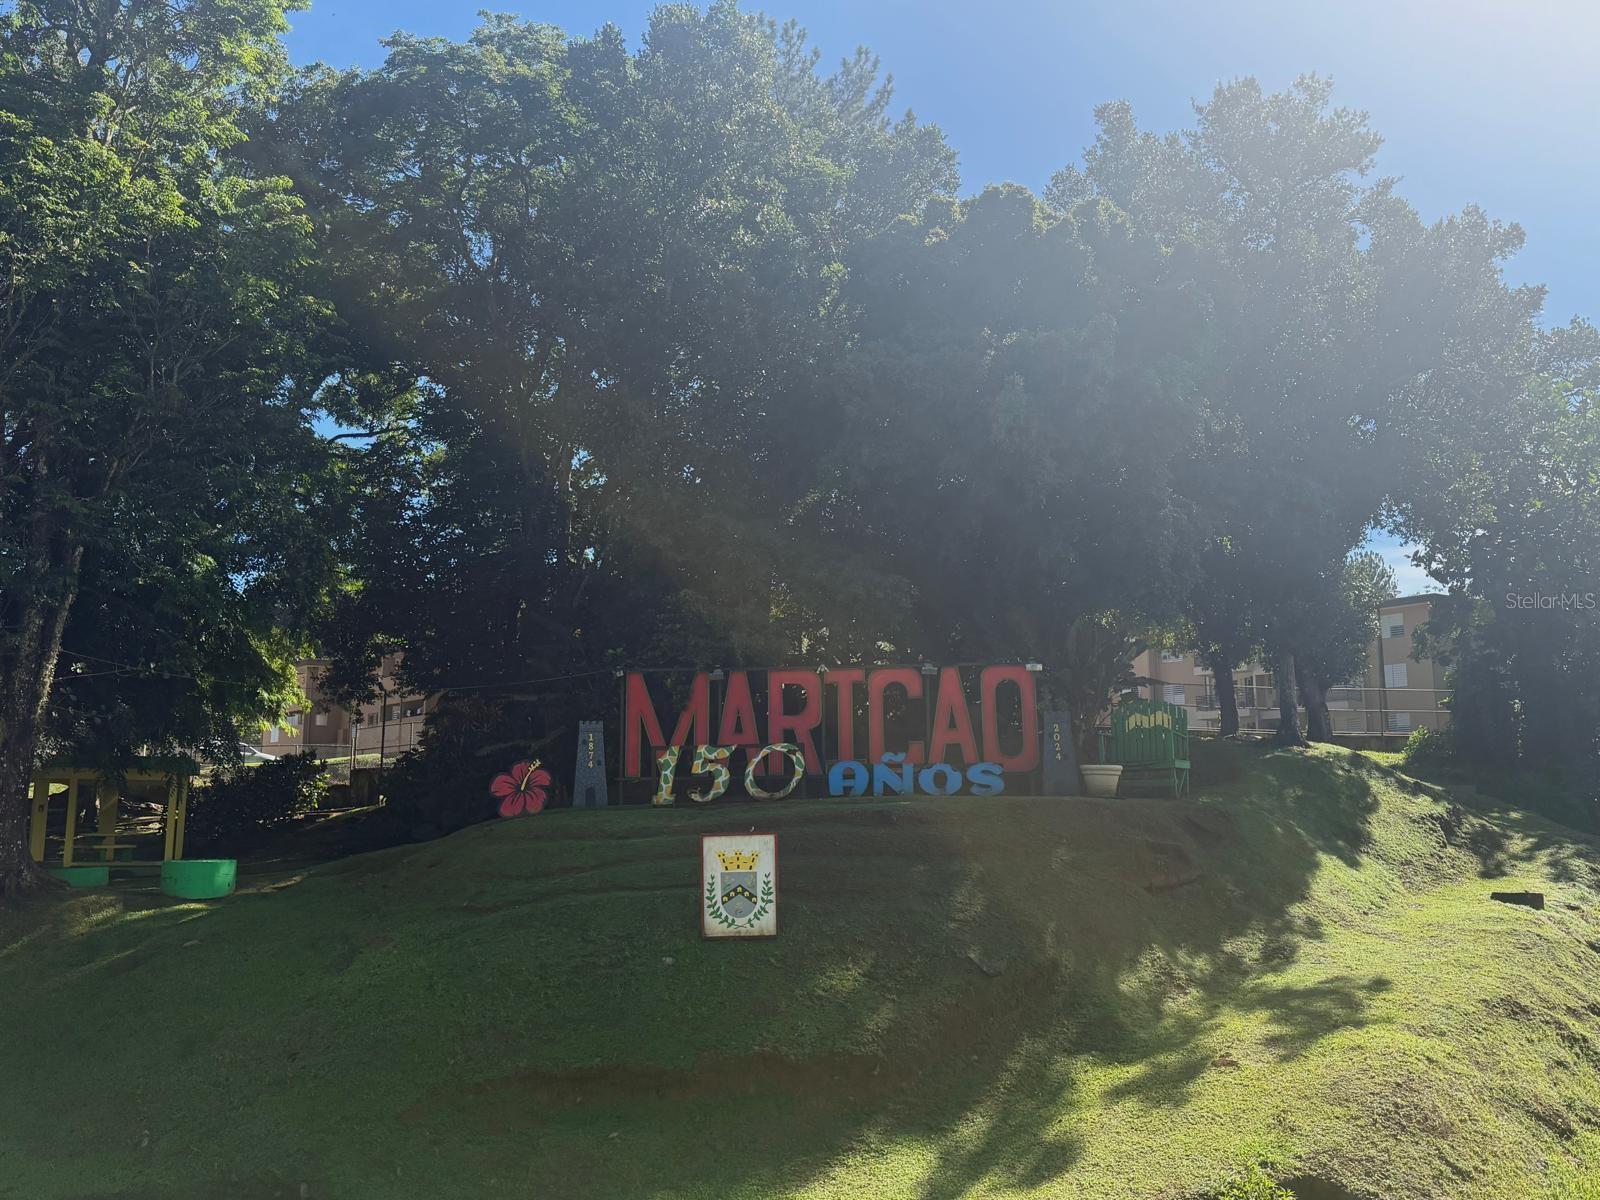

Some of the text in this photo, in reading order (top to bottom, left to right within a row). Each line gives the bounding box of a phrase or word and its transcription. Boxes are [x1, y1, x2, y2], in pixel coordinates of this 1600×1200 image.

[625, 667, 1040, 777] MARICAO
[1053, 723, 1062, 761] 2024
[587, 733, 595, 769] 1874
[651, 743, 1005, 805] 150 AÑOS
